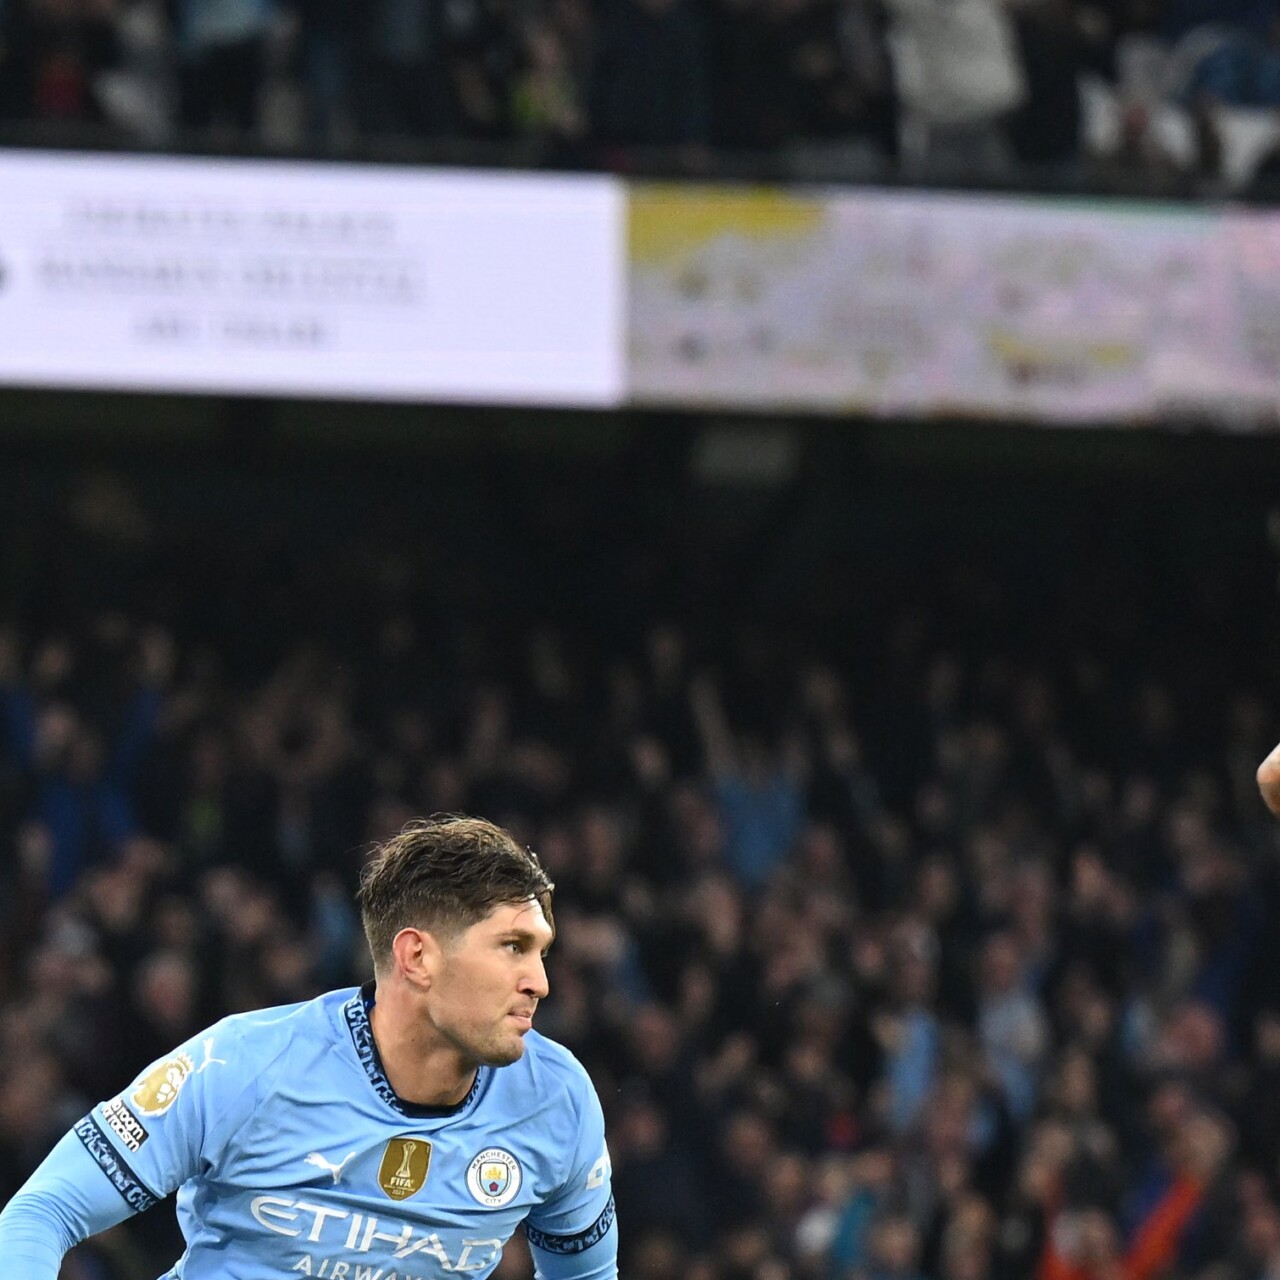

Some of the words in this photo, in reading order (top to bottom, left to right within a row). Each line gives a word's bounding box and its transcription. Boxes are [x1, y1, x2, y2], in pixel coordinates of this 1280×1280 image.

[117, 1104, 144, 1141] room
[471, 1150, 518, 1171] MANCHESTER
[390, 1176, 412, 1188] FIFA
[485, 1197, 502, 1205] CITY
[250, 1195, 503, 1272] ETIHAD
